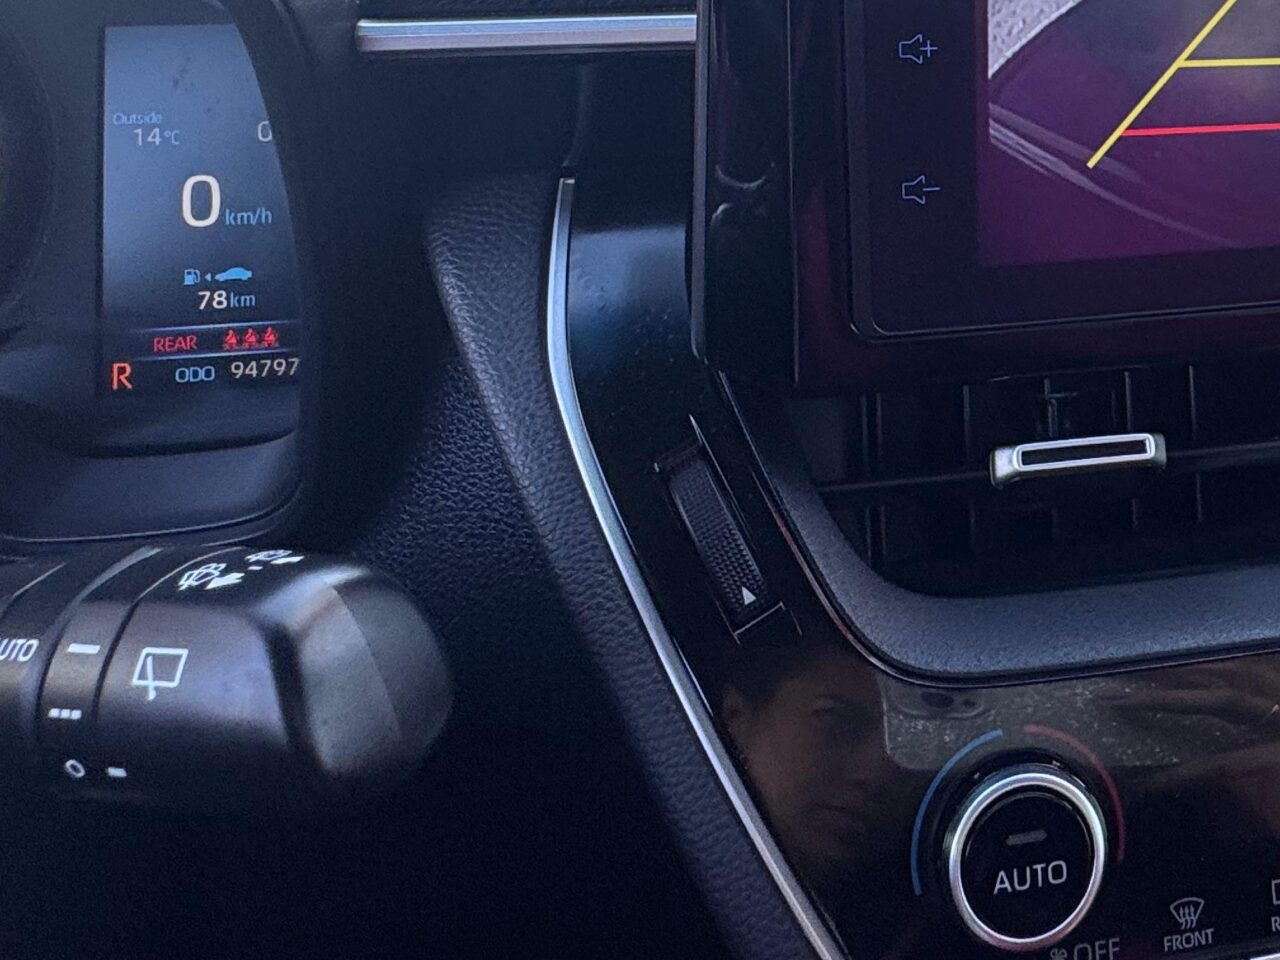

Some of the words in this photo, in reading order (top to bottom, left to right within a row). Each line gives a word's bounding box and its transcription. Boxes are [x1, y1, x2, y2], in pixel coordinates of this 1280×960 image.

[113, 112, 162, 125] Outside
[181, 175, 221, 227] 0
[225, 208, 272, 226] km/h
[153, 335, 197, 353] REAR
[112, 363, 132, 390] R
[175, 366, 215, 384] ODO
[231, 356, 300, 379] 94797
[0, 638, 39, 661] UTO
[992, 860, 1067, 895] AUTO
[1074, 937, 1121, 960] OFF
[1163, 928, 1215, 952] FRONT
